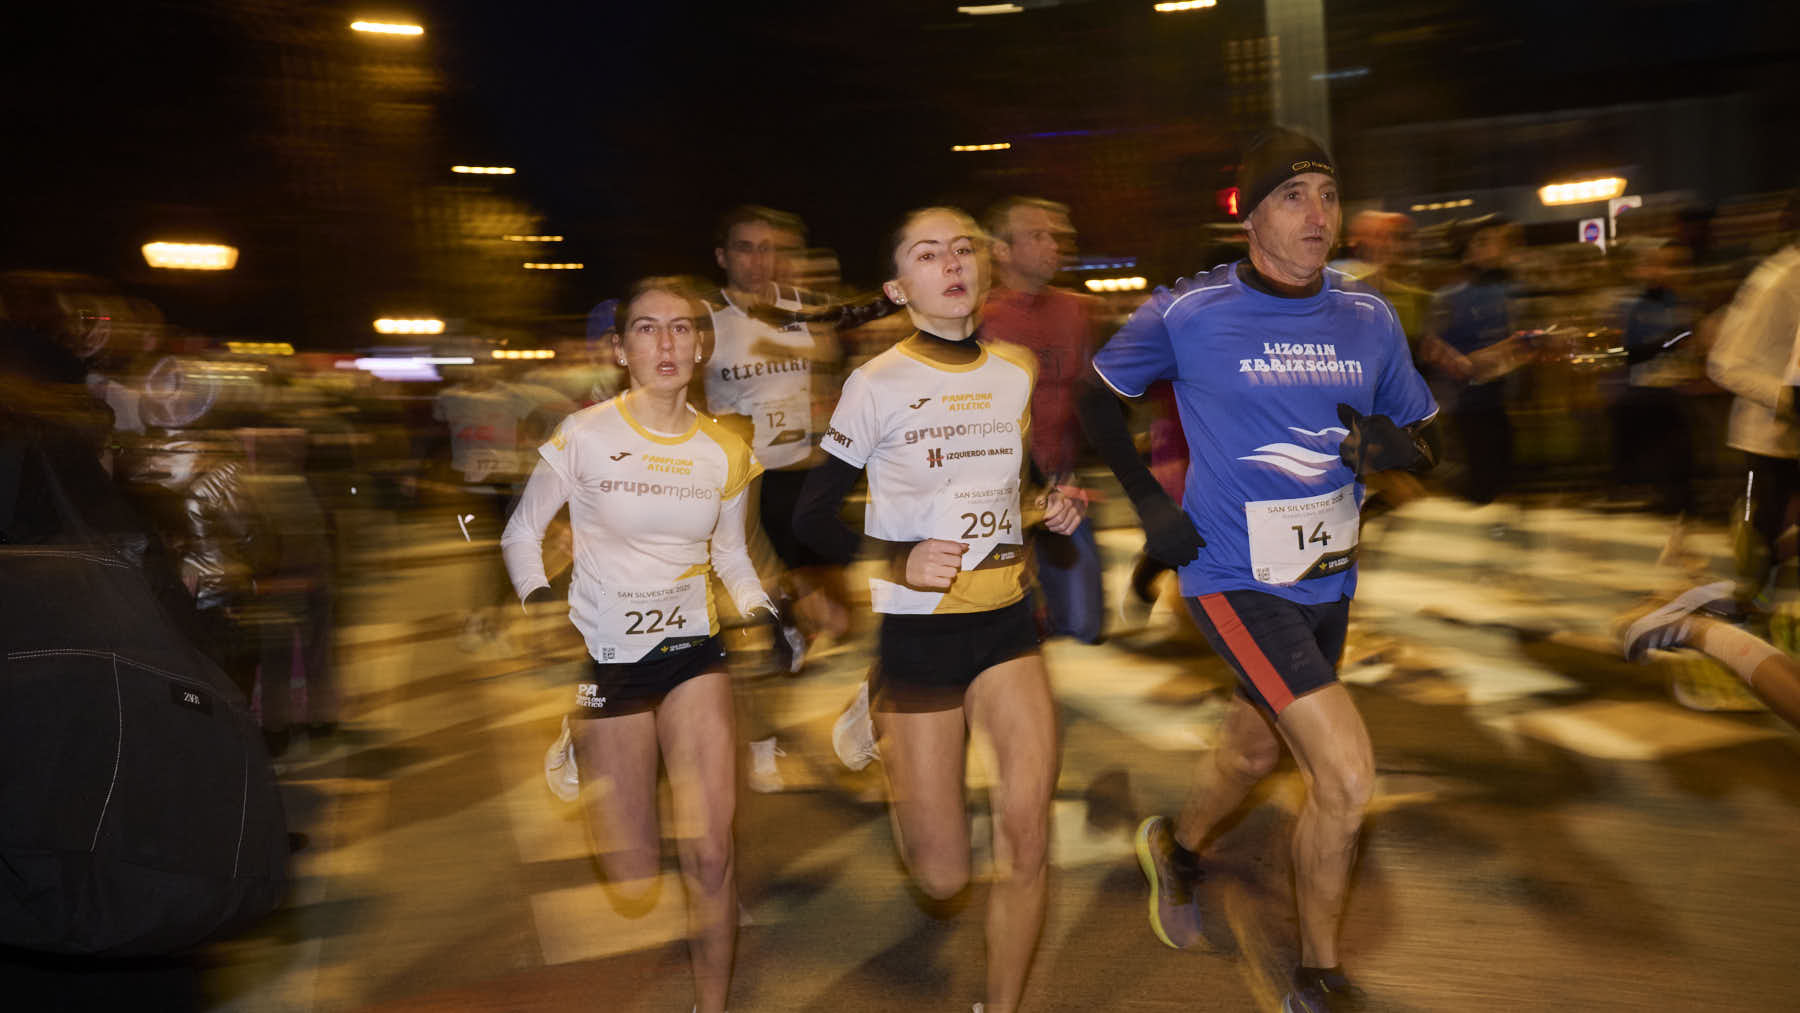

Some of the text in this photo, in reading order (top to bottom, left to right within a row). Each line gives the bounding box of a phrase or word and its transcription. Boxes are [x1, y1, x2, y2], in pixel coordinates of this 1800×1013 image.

[1263, 342, 1336, 356] LIZOAIN
[766, 411, 786, 429] 12
[904, 419, 1014, 445] grupompleo
[599, 479, 713, 500] grupompleo
[1267, 506, 1285, 514] SAN
[1287, 500, 1330, 512] SILVESTRE
[960, 508, 1012, 540] 294
[1291, 521, 1332, 551] 14
[617, 590, 633, 598] SAN
[635, 588, 674, 598] SILVESTRE
[624, 605, 687, 636] 224
[578, 683, 599, 696] PA
